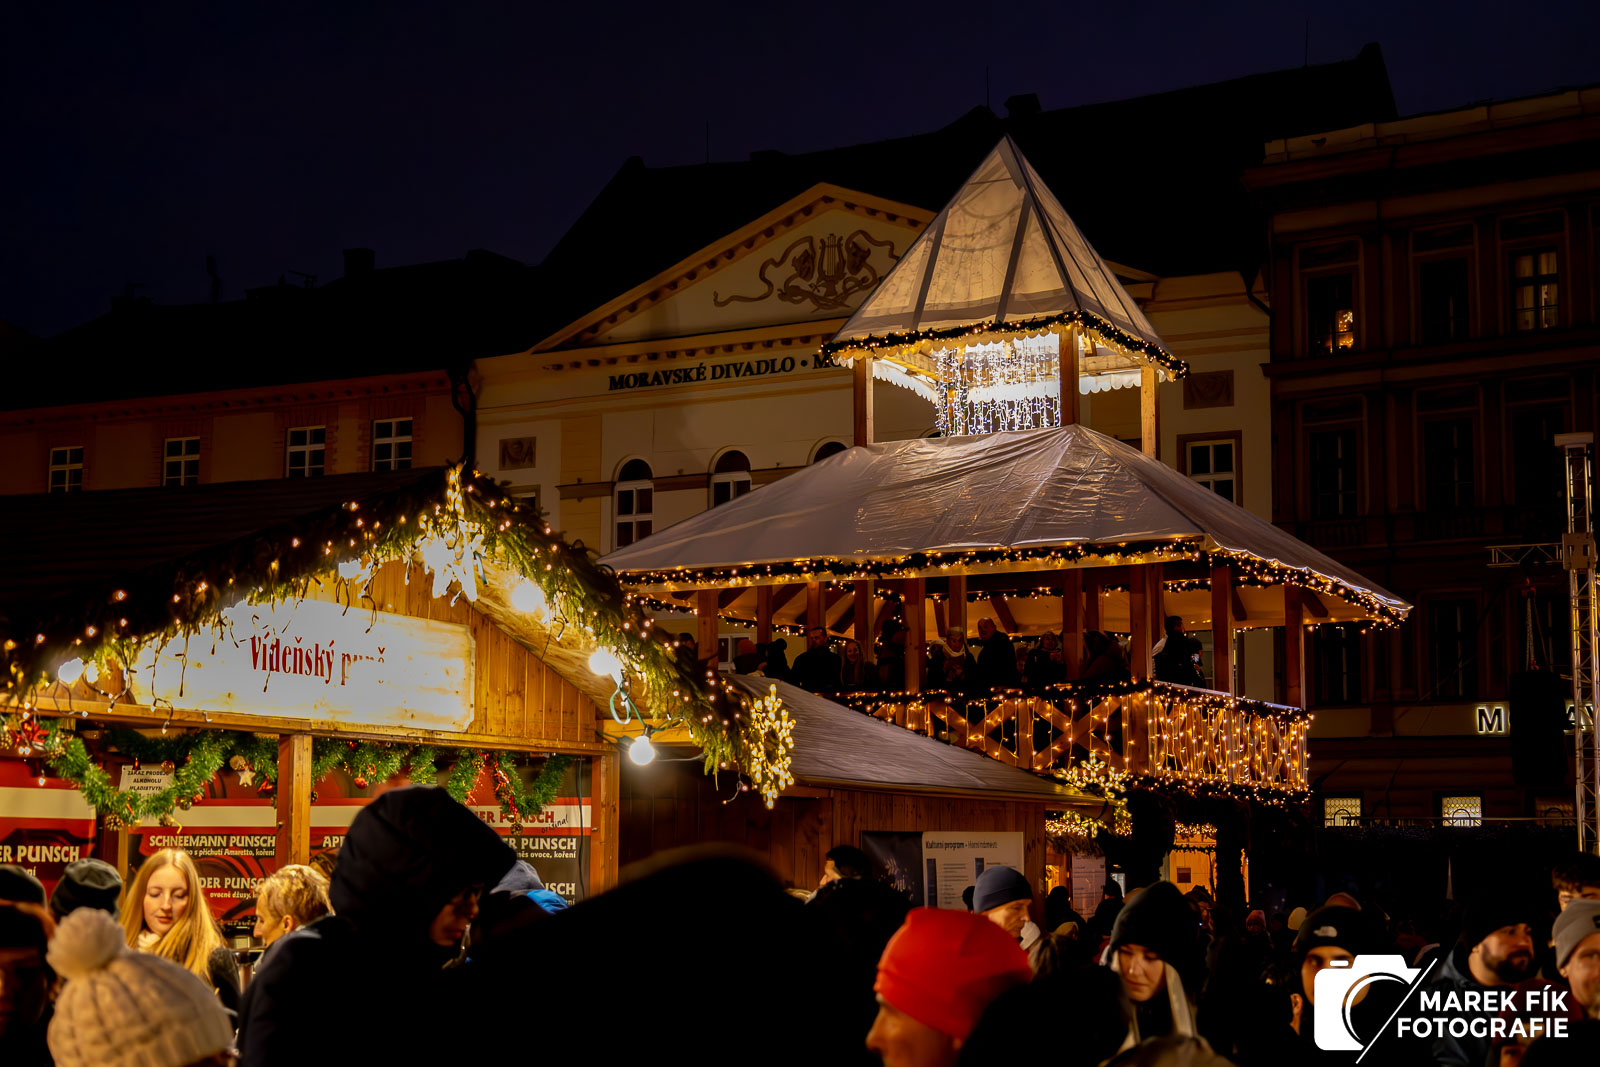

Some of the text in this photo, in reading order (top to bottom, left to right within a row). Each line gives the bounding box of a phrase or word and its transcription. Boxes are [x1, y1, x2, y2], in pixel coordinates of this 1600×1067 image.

[608, 363, 707, 391] MORAVSKÉ
[710, 356, 796, 380] DIVADLO
[250, 631, 335, 685] Vídeňský
[149, 835, 277, 847] SCHNEEMANN PUNSCH
[521, 837, 577, 850] PUNSCH
[17, 845, 80, 863] PUNSCH
[553, 850, 577, 858] koření
